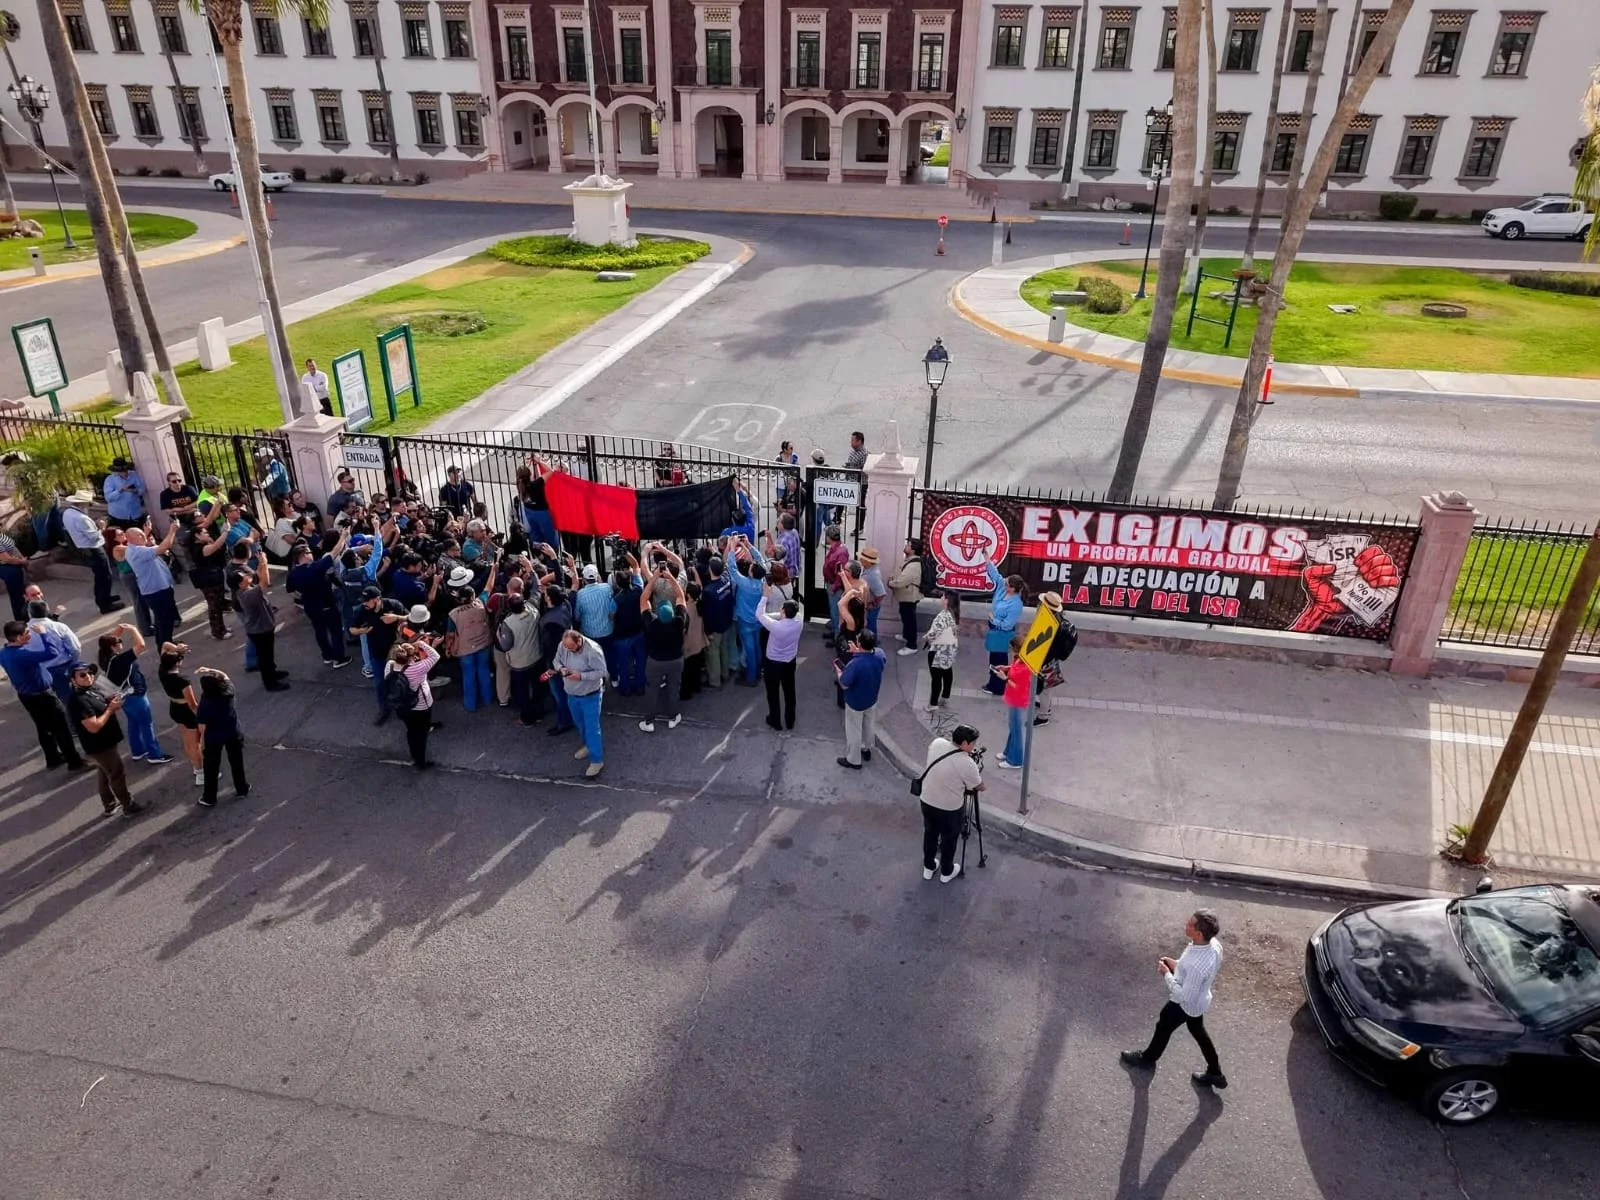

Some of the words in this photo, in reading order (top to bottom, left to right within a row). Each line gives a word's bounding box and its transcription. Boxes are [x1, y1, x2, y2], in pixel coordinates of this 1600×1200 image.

[696, 418, 763, 443] 20
[345, 451, 381, 464] ENTRADA
[817, 486, 855, 499] ENTRADA
[1021, 506, 1309, 562] EXIGIMOS
[1046, 542, 1070, 558] UN
[1078, 545, 1179, 565] PROGRAMA
[1187, 550, 1271, 573] GRADUAL
[1328, 547, 1356, 562] ISR
[950, 577, 981, 587] STAUS
[1043, 562, 1072, 583] DE
[1083, 565, 1240, 597] ADECUACIÓN
[1249, 580, 1266, 600] A
[1062, 583, 1090, 604] LA
[1100, 586, 1144, 608] LEY
[1151, 591, 1190, 614] DEL
[1200, 594, 1241, 618] ISR
